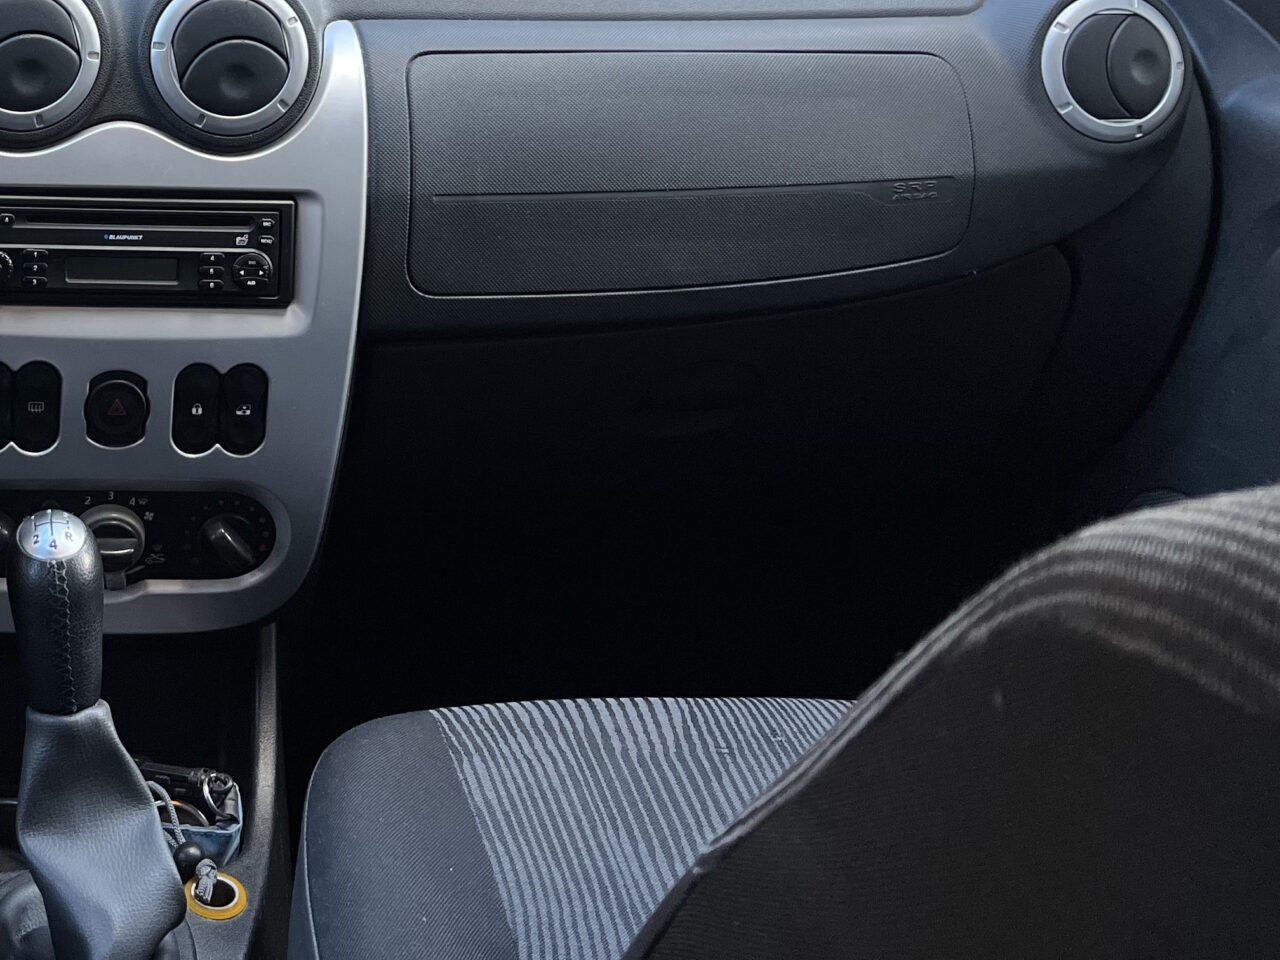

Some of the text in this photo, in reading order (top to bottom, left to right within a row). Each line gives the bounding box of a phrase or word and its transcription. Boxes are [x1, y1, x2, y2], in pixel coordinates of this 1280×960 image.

[84, 491, 136, 506] 2 3 4
[32, 531, 73, 550] 2 4 R
